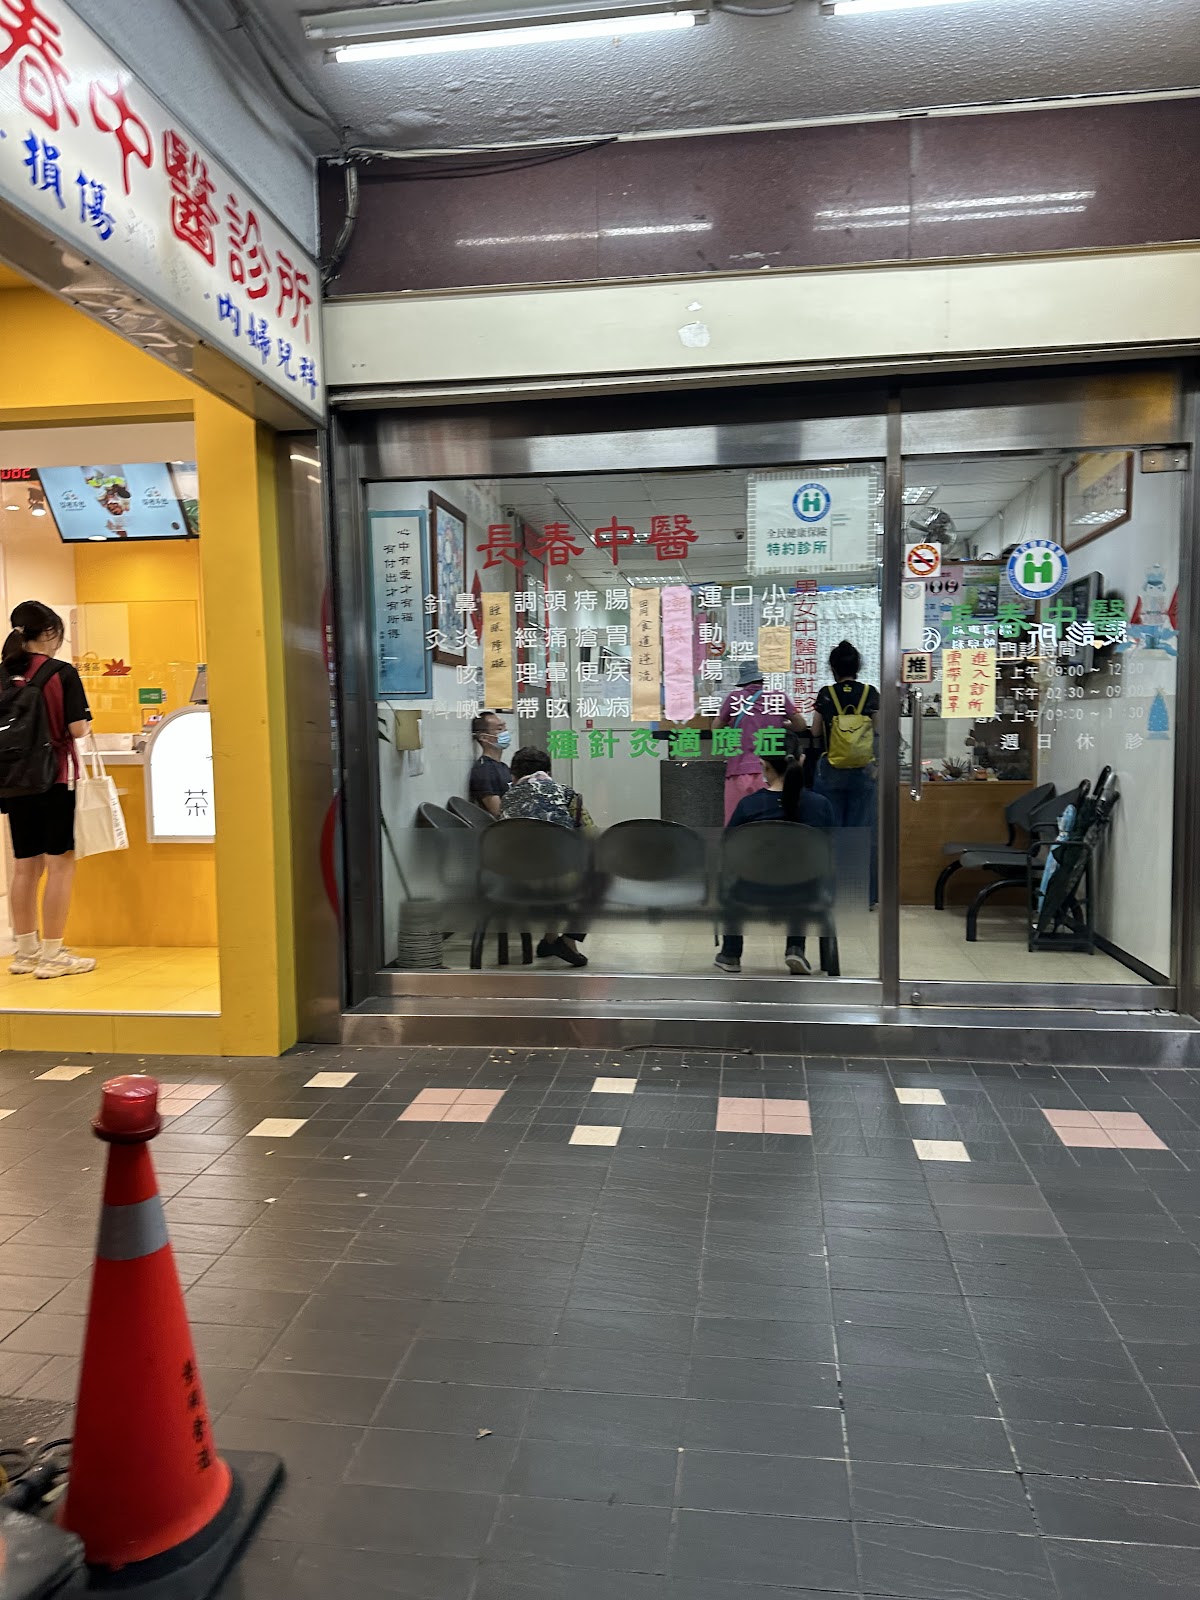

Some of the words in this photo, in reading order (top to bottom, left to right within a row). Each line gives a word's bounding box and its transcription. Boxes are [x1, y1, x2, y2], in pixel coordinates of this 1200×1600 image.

[476, 515, 699, 569] 長春中醫
[767, 527, 828, 538] 全民健康保險
[767, 541, 827, 556] 特約診所
[383, 544, 400, 639] 有付出才有所得
[397, 528, 414, 622] 心中有愛才有福
[794, 579, 819, 713] 男女中醫師駐診
[942, 599, 1129, 641] 長春中醫
[1000, 641, 1076, 658] 門診時間
[454, 592, 482, 719] 鼻炎咳嗽
[514, 590, 540, 719] 調經理帶
[543, 589, 569, 719] 頭痛暈眩
[574, 588, 601, 718] 痔瘡便秘
[604, 588, 630, 718] 腸胃疾病
[698, 586, 724, 717] 運動傷害
[730, 586, 756, 717] 口腔炎
[907, 657, 926, 673] 推
[968, 651, 991, 712] 進入診所
[1010, 666, 1039, 680] 上午
[1046, 665, 1084, 677] 09:00
[1010, 687, 1039, 700] 下午
[1010, 709, 1039, 722] 上午
[1108, 707, 1144, 720] 1:30
[547, 727, 787, 760] 種針灸適應症
